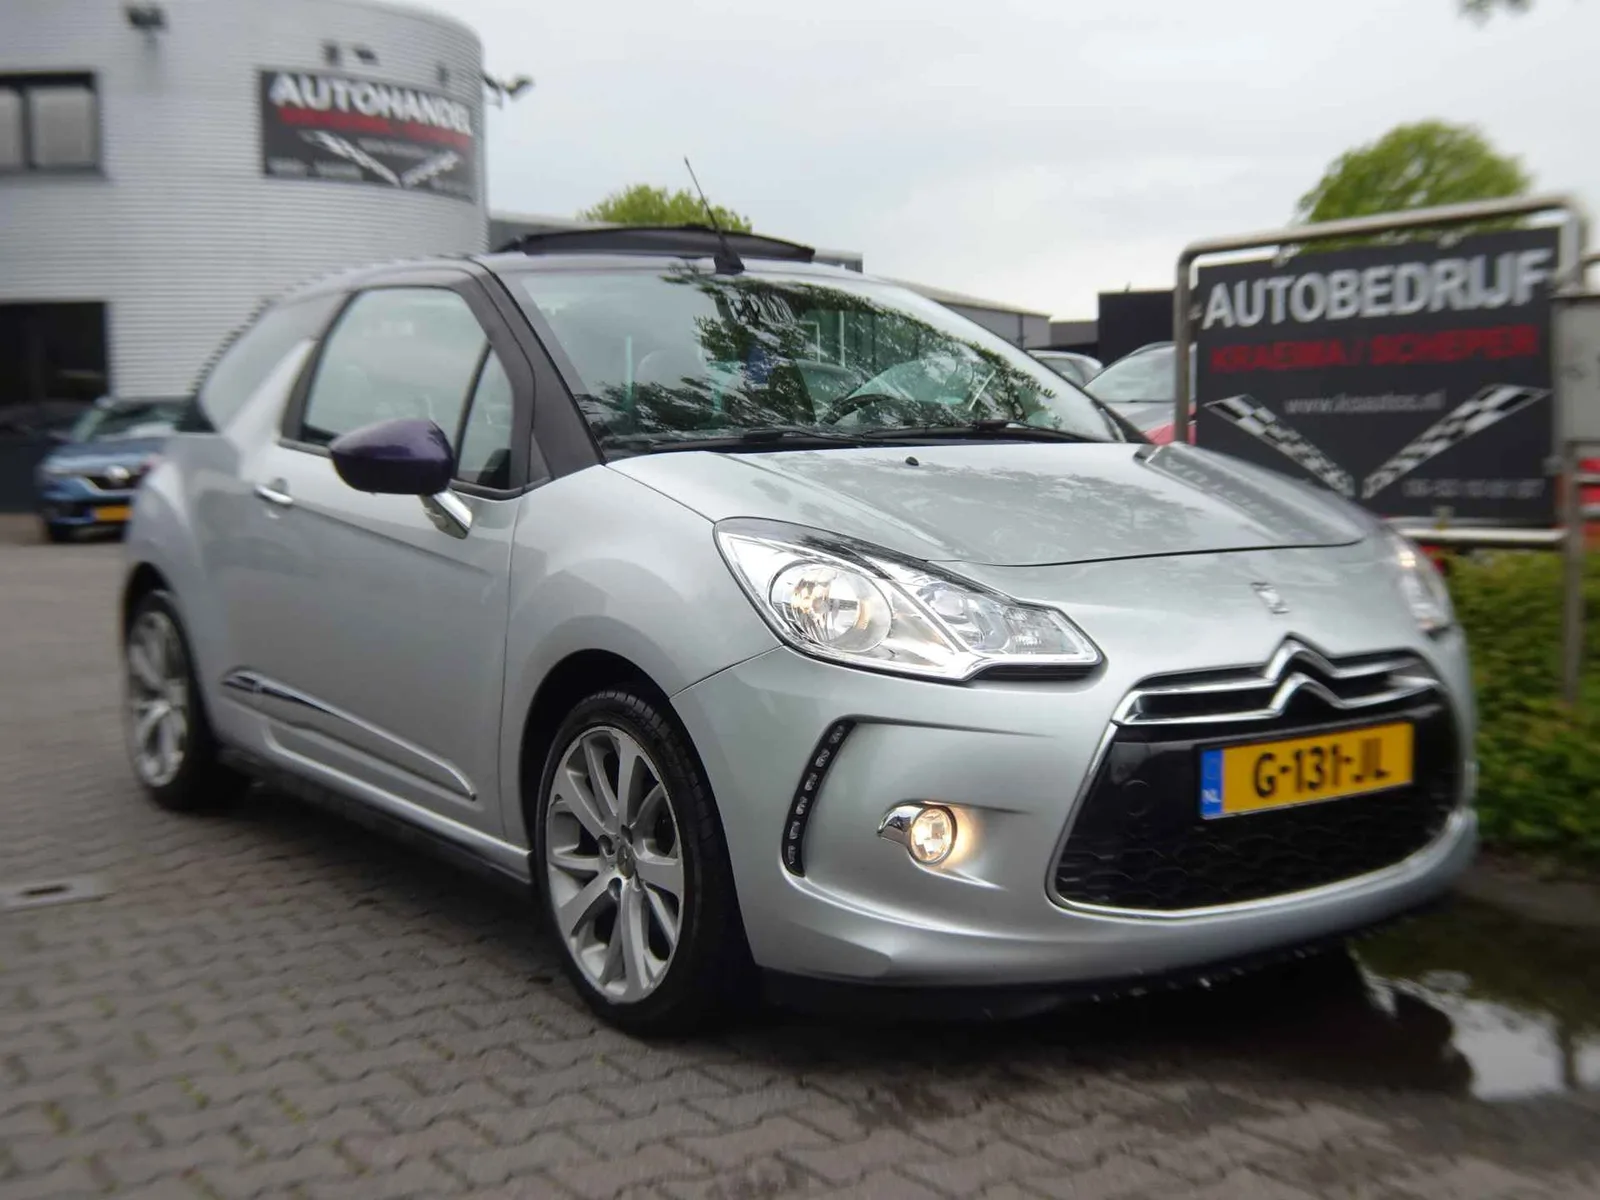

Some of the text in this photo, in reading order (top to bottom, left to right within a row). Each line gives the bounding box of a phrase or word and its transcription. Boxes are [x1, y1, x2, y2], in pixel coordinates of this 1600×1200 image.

[269, 73, 473, 136] AUTOHANDEL
[1202, 249, 1551, 329] AUTOBEDRIJF
[1371, 325, 1539, 364] SCHEPER
